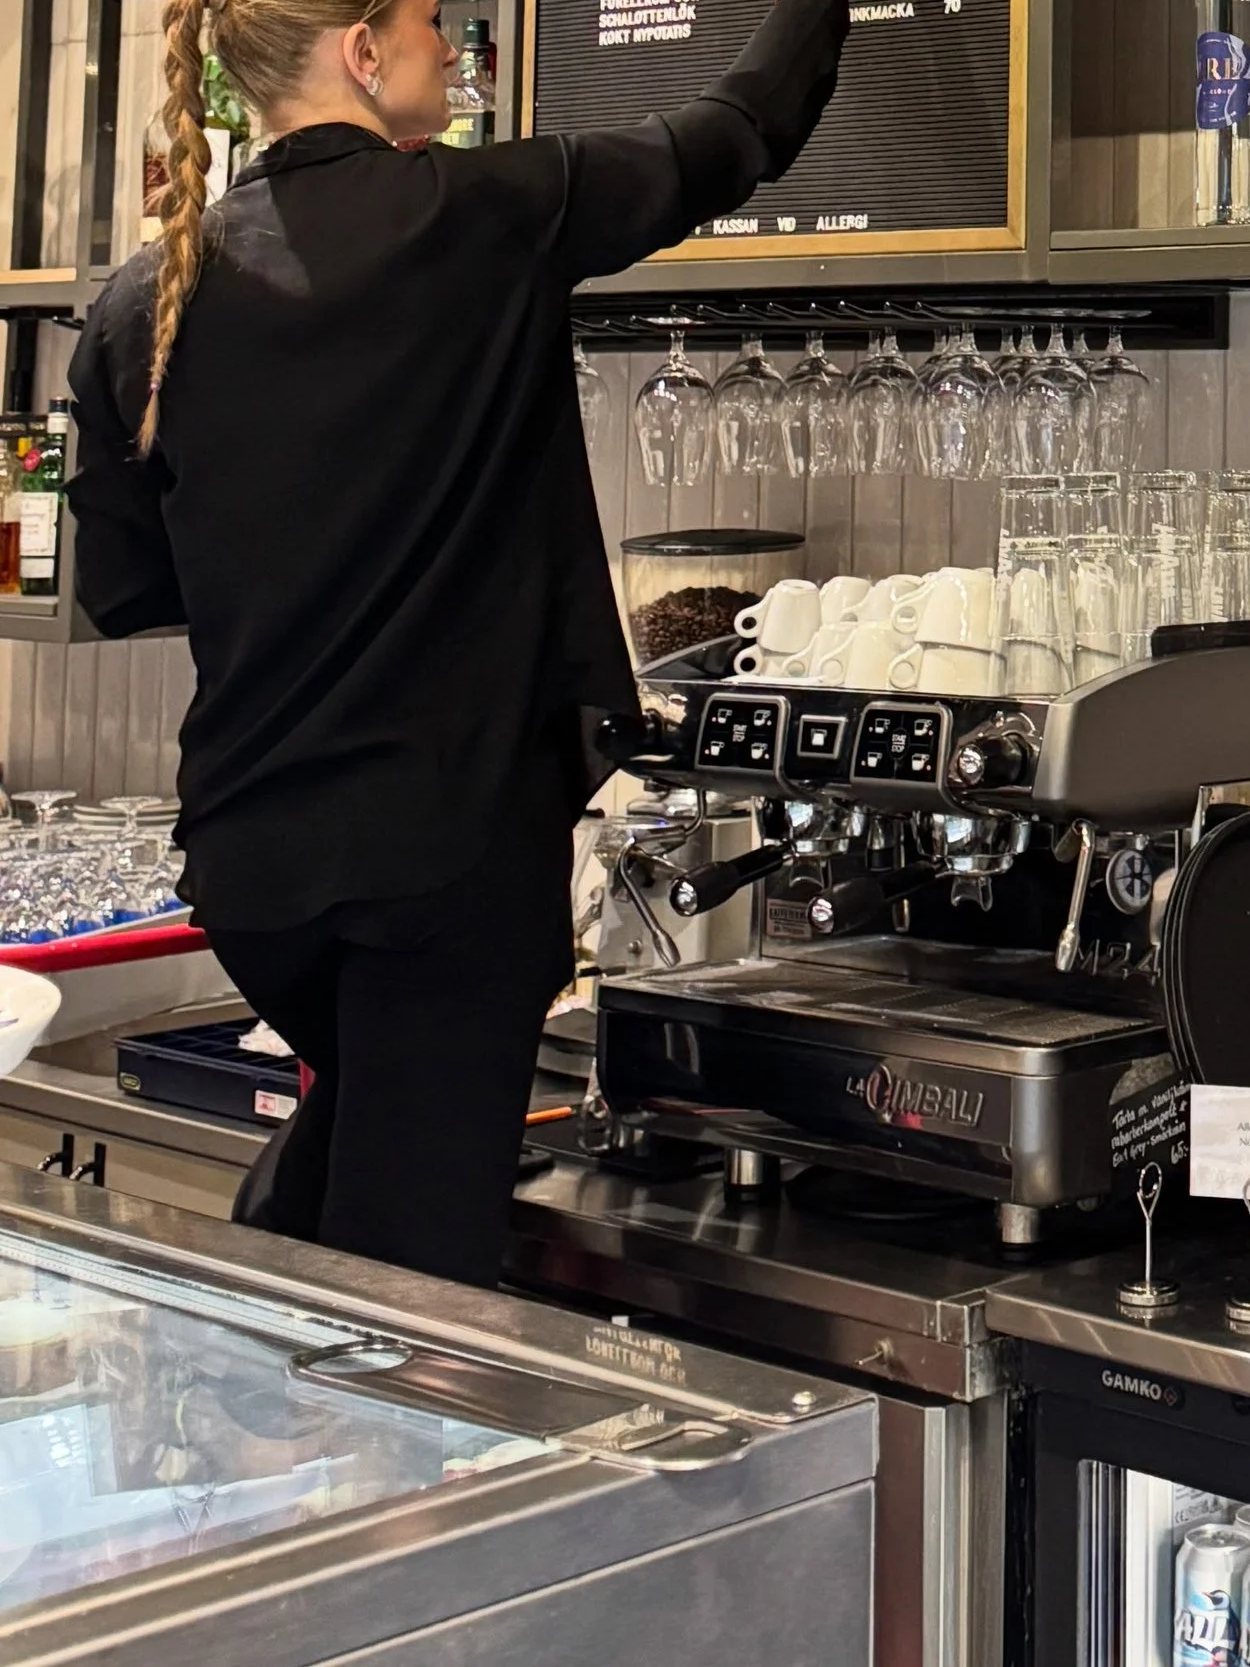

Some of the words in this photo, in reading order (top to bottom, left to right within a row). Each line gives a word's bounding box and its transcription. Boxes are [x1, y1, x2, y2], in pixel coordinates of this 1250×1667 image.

[599, 4, 696, 28] SCHALOTTENLÖK
[599, 29, 630, 46] KOKT
[634, 24, 691, 42] NYPOTATIS
[713, 218, 758, 234] KASSAN
[777, 217, 796, 231] VID
[816, 214, 868, 230] ALLERGI
[1101, 1370, 1162, 1401] GAMKO
